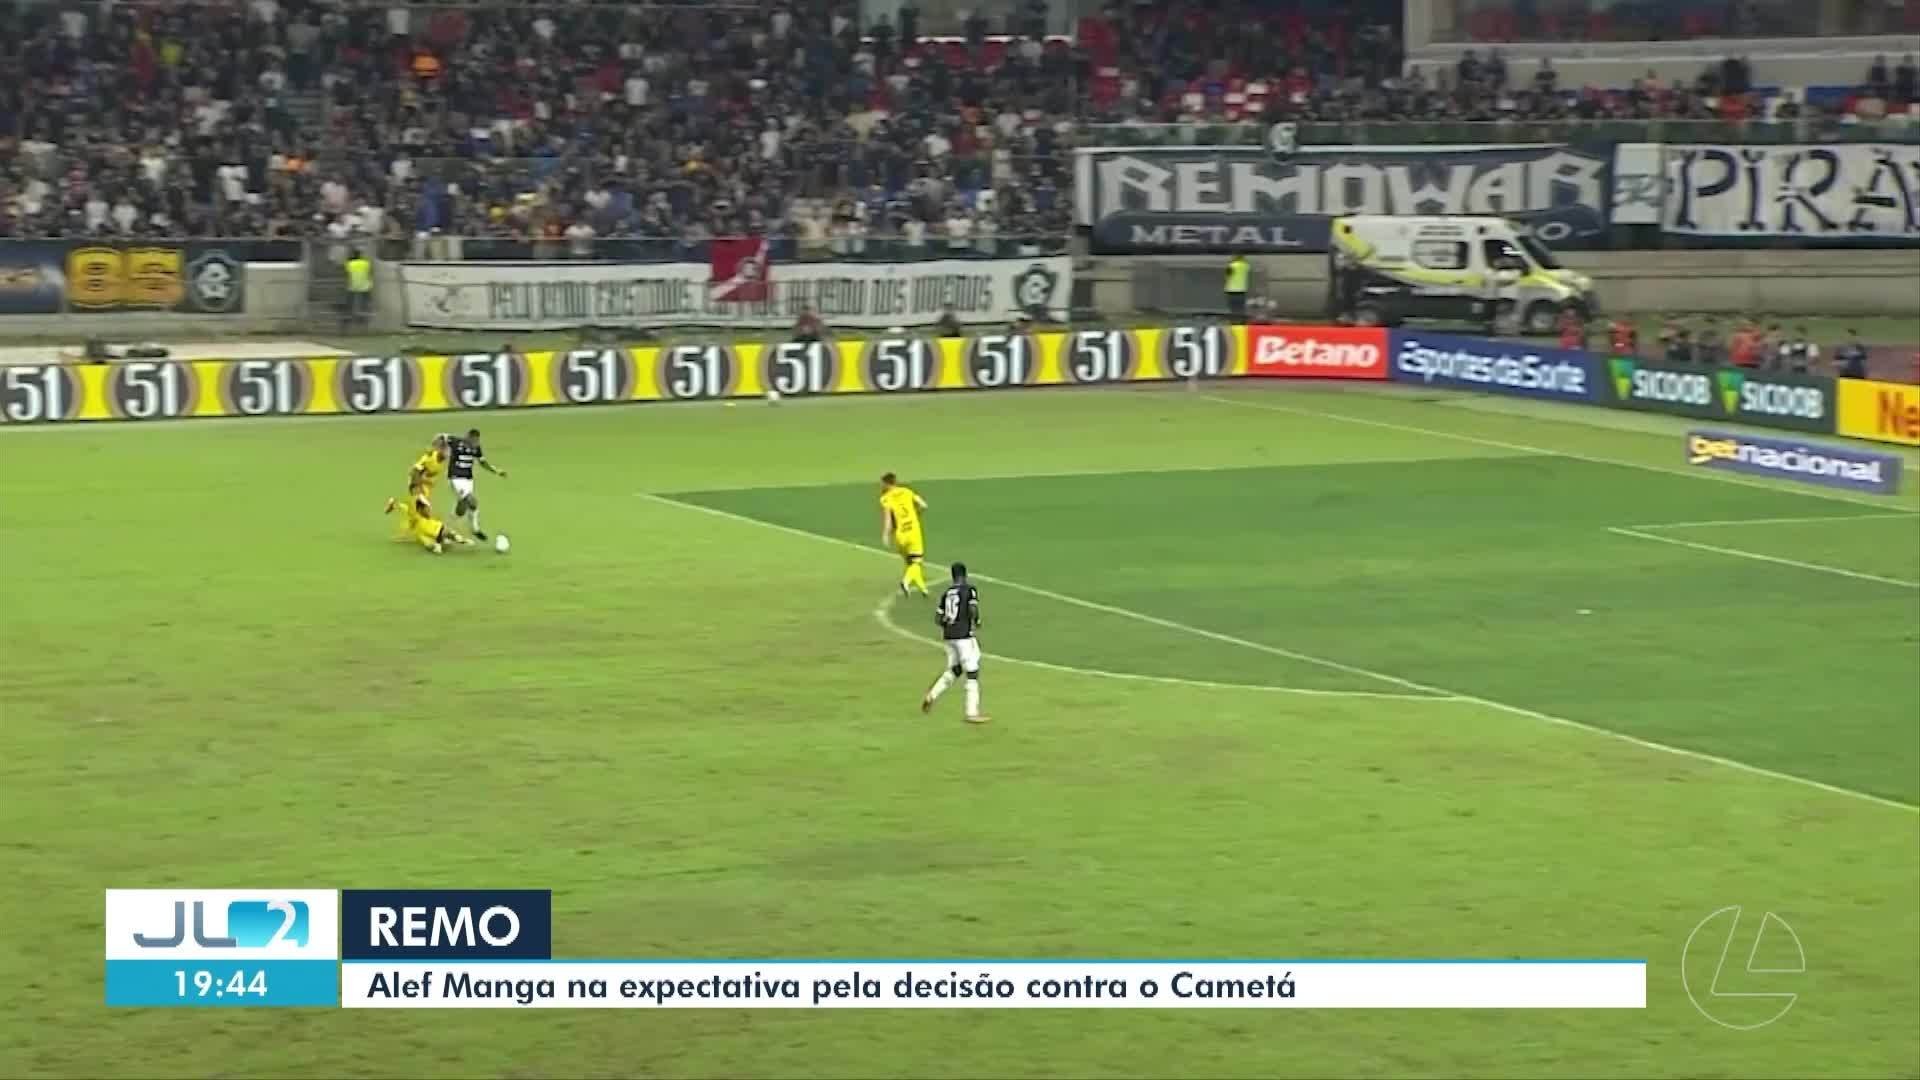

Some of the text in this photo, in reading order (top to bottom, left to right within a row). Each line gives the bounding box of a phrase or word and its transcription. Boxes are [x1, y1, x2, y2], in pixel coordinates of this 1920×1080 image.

[1674, 149, 1920, 232] PIRA
[1130, 224, 1302, 246] METAL
[568, 349, 617, 402] 51
[672, 345, 721, 398] 51
[775, 342, 823, 395] 51
[876, 338, 924, 391] 51
[976, 335, 1024, 387] 51
[1076, 330, 1123, 382] 51
[1174, 326, 1219, 377] 51
[1255, 335, 1380, 368] Betano
[7, 366, 62, 421] 51
[124, 363, 178, 417] 51
[239, 360, 291, 414] 51
[352, 357, 403, 411] 51
[460, 353, 512, 407] 51
[1632, 369, 1712, 405] SICOOB
[1741, 380, 1824, 418] SICOOB
[1689, 434, 1884, 483] betnacional
